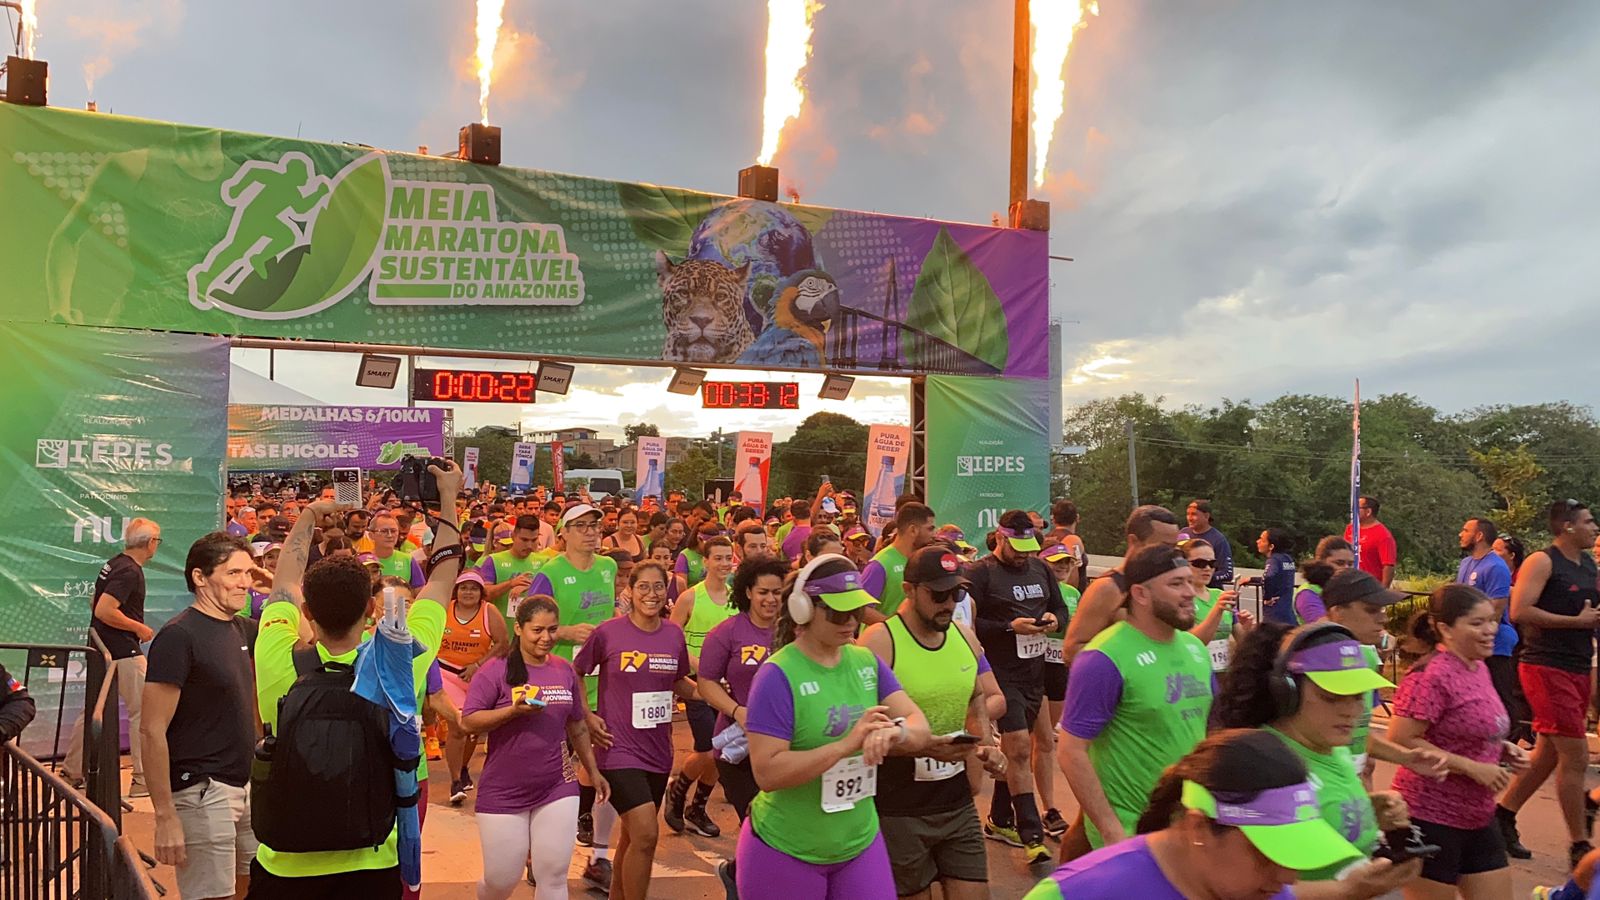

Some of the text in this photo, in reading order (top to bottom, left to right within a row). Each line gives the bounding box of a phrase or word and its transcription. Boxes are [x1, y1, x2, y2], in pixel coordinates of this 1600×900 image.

[389, 187, 491, 222] MEIA
[384, 225, 561, 254] MARATONA
[379, 253, 577, 281] SUSTENTÁVEL
[453, 284, 579, 299] DO AMAZONAS
[367, 370, 392, 378] SMART
[435, 372, 534, 400] 0:00:22
[260, 407, 431, 424] MEDALHAS 6/10KM
[880, 432, 900, 440] PURA
[69, 440, 173, 466] IEPES
[282, 440, 359, 459] PICOLÉS
[973, 456, 1026, 472] IEPES
[431, 549, 453, 564] Canon
[641, 706, 665, 719] 1880
[835, 776, 863, 798] 892
